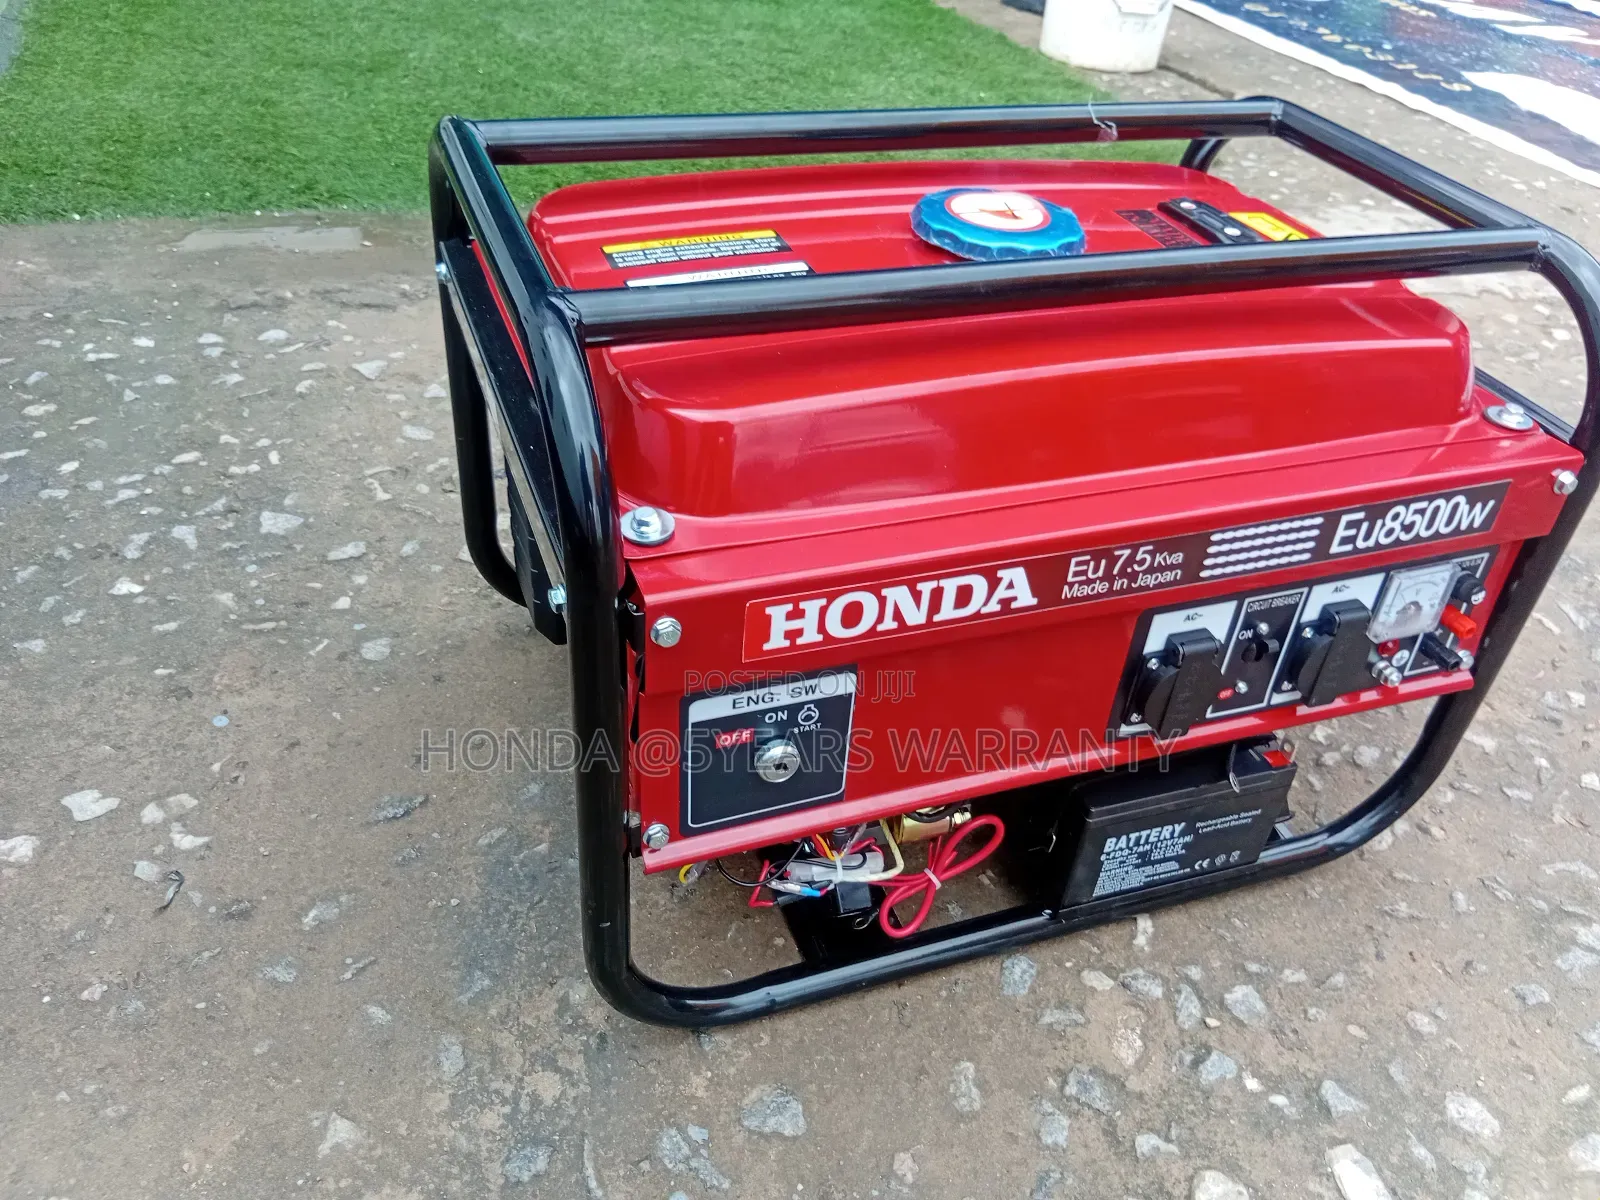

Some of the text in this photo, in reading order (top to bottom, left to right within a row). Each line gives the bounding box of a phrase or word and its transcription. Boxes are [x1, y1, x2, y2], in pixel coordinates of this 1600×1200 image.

[660, 235, 744, 247] WARNING
[1329, 494, 1496, 554] Eu8500w
[1067, 545, 1184, 582] Eu 7.5 Kva
[1061, 569, 1182, 600] Made in Japan
[762, 566, 1038, 650] HONDA
[1247, 593, 1301, 613] CIRCUIT BREAKER
[1238, 628, 1254, 641] ON
[731, 682, 823, 710] ENG. SW.
[764, 709, 788, 724] ON
[793, 722, 822, 734] START
[719, 730, 752, 747] OFF
[1103, 822, 1186, 853] BATTERY
